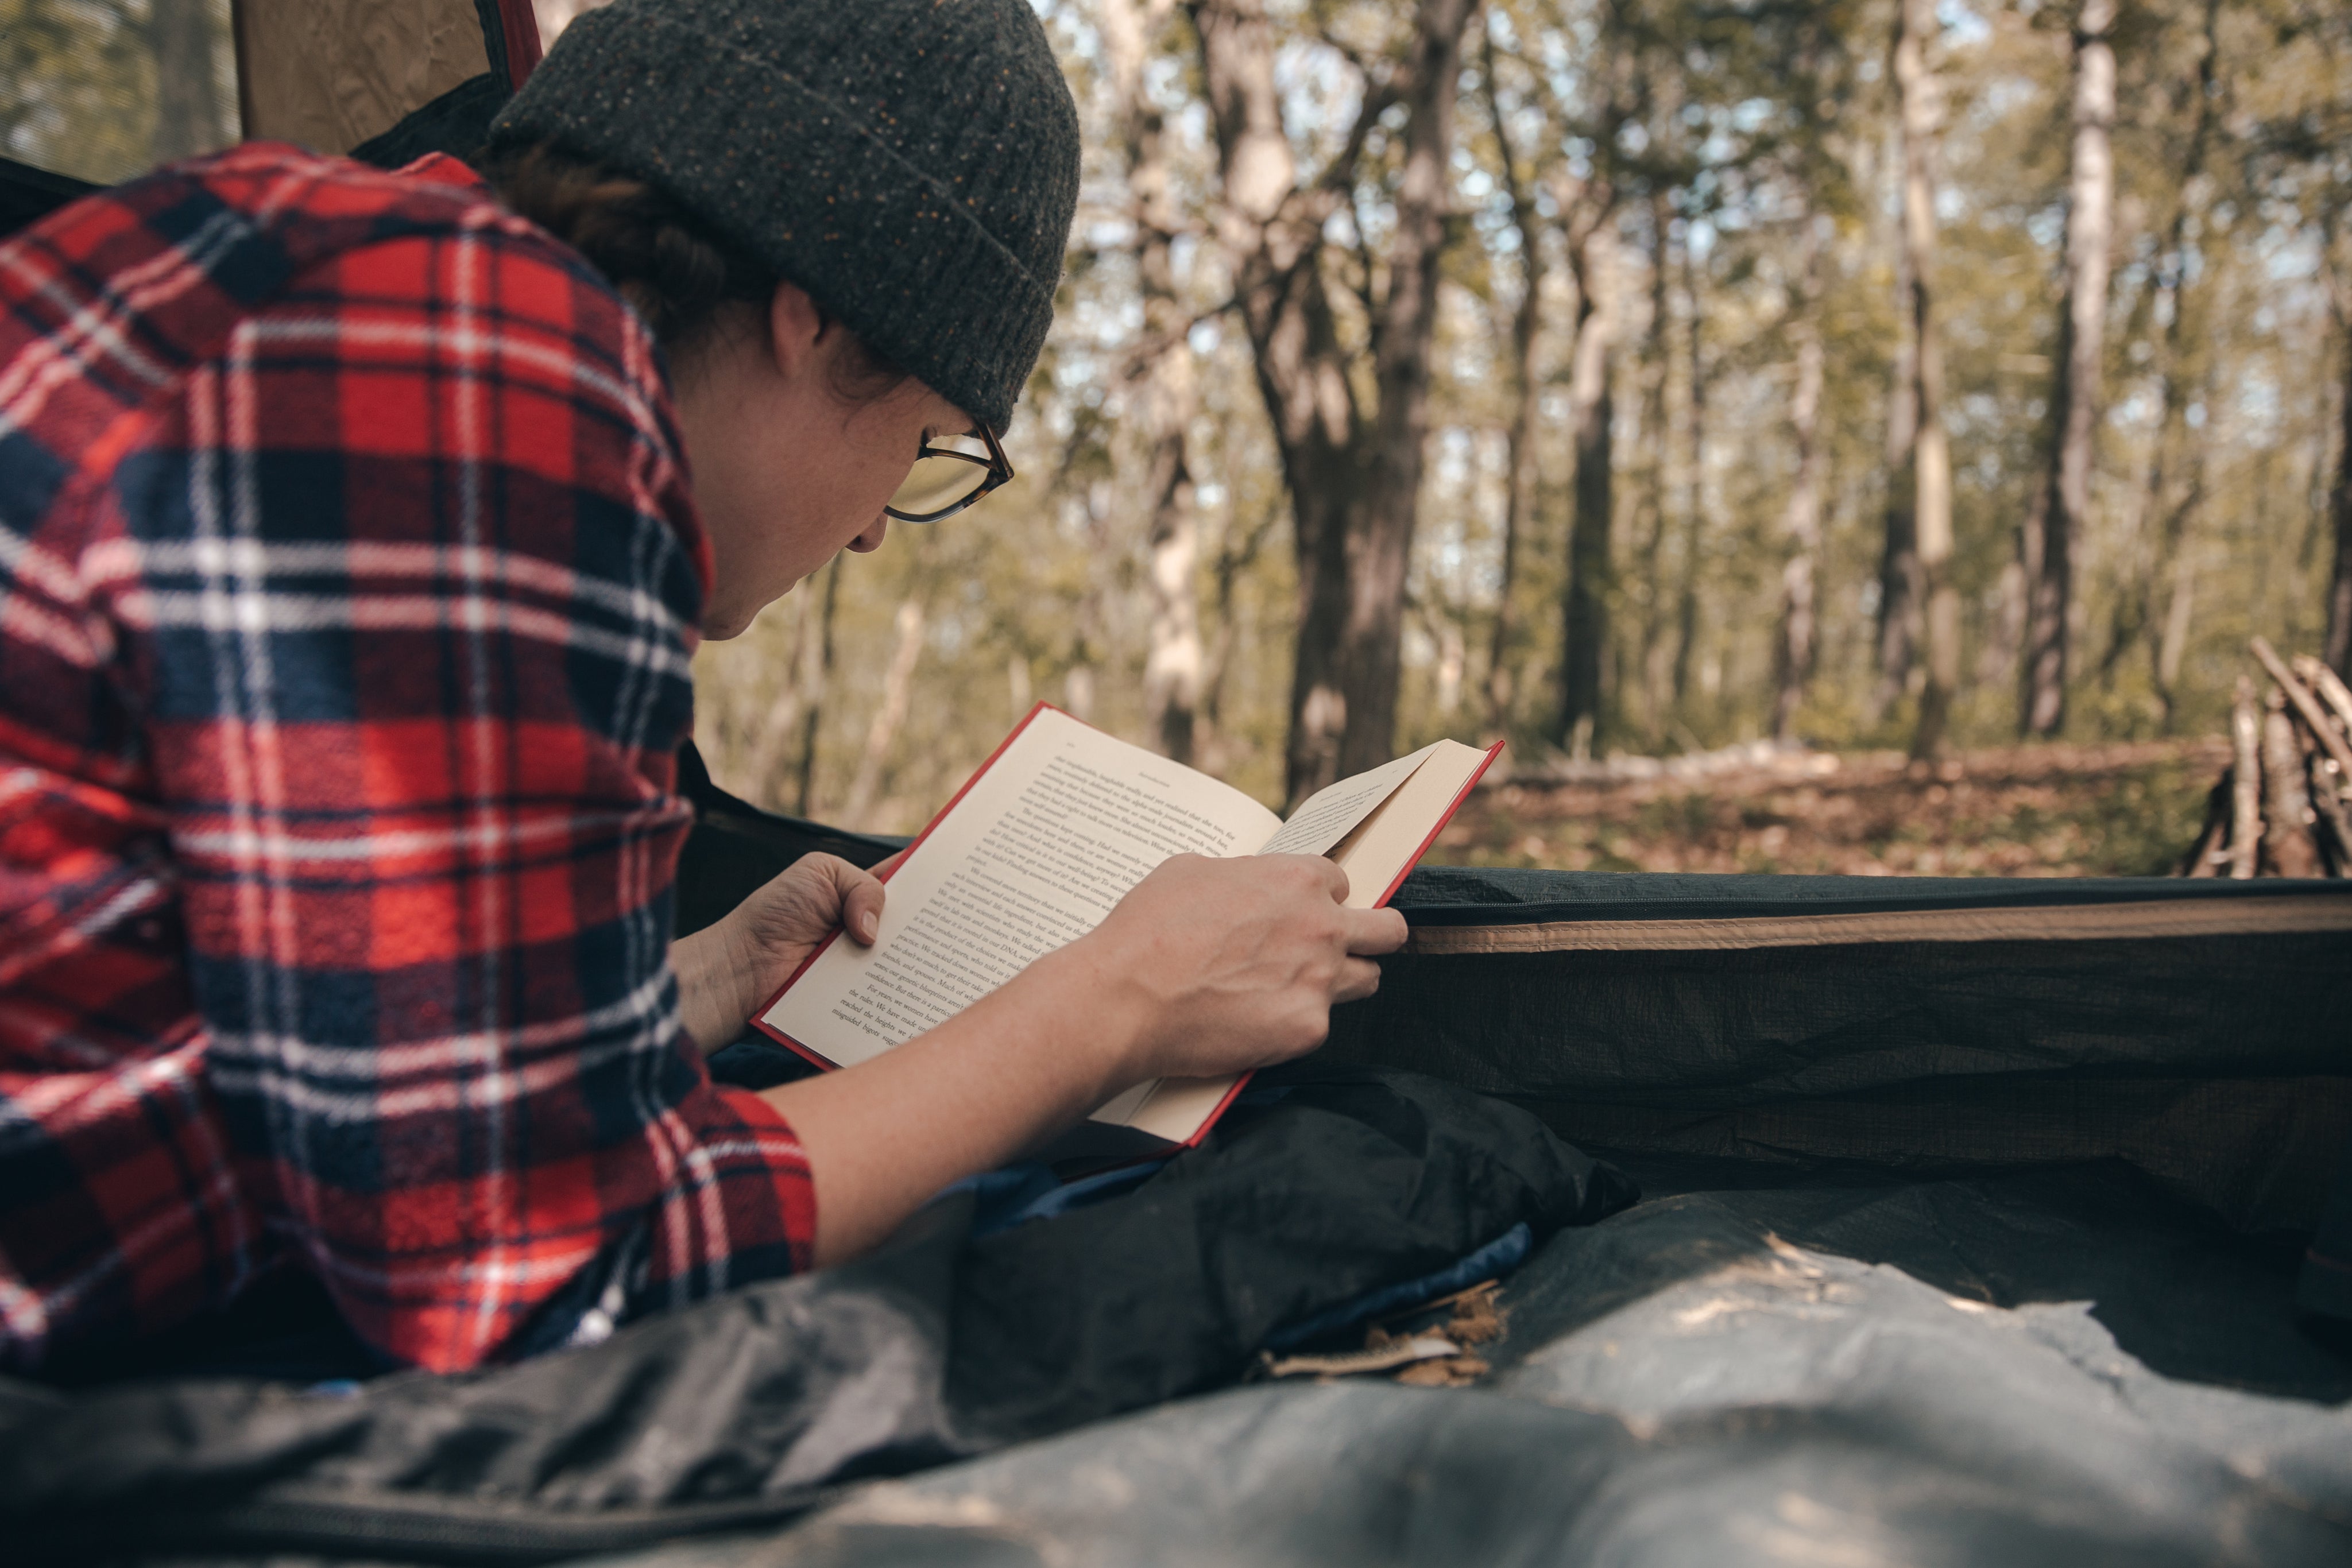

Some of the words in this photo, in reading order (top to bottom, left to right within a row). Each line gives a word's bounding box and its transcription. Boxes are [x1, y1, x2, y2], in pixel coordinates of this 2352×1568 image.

[1150, 831, 1189, 851] unconsciously
[1194, 828, 1217, 841] around
[1216, 838, 1228, 850] her,
[1201, 819, 1212, 827] she
[1213, 824, 1224, 835] too,
[1225, 831, 1235, 841] for
[1120, 853, 1142, 865] merely
[1150, 840, 1166, 852] Were
[1186, 836, 1204, 847] much
[1205, 846, 1221, 856] more
[1067, 864, 1100, 881] well-being?
[1100, 877, 1109, 886] To
[1095, 866, 1120, 878] anyway?
[1105, 858, 1127, 870] women
[1128, 868, 1144, 878] really
[1058, 884, 1074, 894] these
[1073, 892, 1101, 907] questions
[1068, 876, 1080, 885] Are
[1090, 887, 1114, 901] creating
[975, 908, 1001, 923] scientists
[1002, 920, 1015, 929] who
[1016, 928, 1033, 938] study
[1033, 935, 1044, 943] the
[1003, 908, 1033, 927] ingredient,
[1035, 922, 1047, 931] but
[1047, 929, 1060, 938] also
[1015, 902, 1036, 914] answer
[1035, 912, 1066, 928] convinced
[1040, 900, 1054, 910] than
[1063, 911, 1087, 926] initially
[962, 927, 983, 939] rooted
[999, 943, 1017, 958] DNA,
[975, 946, 997, 959] choices
[982, 924, 1008, 940] monkeys.
[1011, 935, 1021, 945] We
[1021, 943, 1041, 954] talked
[901, 948, 916, 959] don't
[922, 959, 939, 971] much,
[956, 976, 971, 986] their
[970, 984, 983, 993] take.
[921, 943, 931, 953] We
[930, 950, 953, 963] tracked
[951, 960, 968, 972] down
[969, 969, 990, 982] women
[939, 942, 953, 950] and
[950, 947, 969, 960] sports,
[970, 957, 983, 966] who
[983, 963, 997, 972] told
[881, 951, 900, 966] friends,
[902, 963, 915, 971] and
[914, 969, 935, 982] spouses.
[937, 978, 955, 992] Much
[865, 971, 894, 988] confidence.
[895, 984, 907, 994] But
[906, 991, 921, 1001] there
[873, 962, 889, 972] sexes;
[897, 975, 919, 987] genetic
[919, 983, 947, 1001] blueprints
[947, 999, 964, 1009] aren't
[840, 999, 863, 1013] reached
[863, 1011, 873, 1019] the
[874, 1016, 895, 1031] heights
[848, 989, 858, 997] the
[858, 995, 873, 1005] rules.
[876, 1001, 885, 1011] We
[886, 1008, 900, 1019] have
[900, 1017, 916, 1027] made
[866, 984, 878, 993] For
[876, 991, 892, 1002] years,
[903, 1004, 923, 1017] women
[924, 1013, 938, 1024] have
[831, 1008, 862, 1026] misguided
[862, 1023, 880, 1036] bigots
